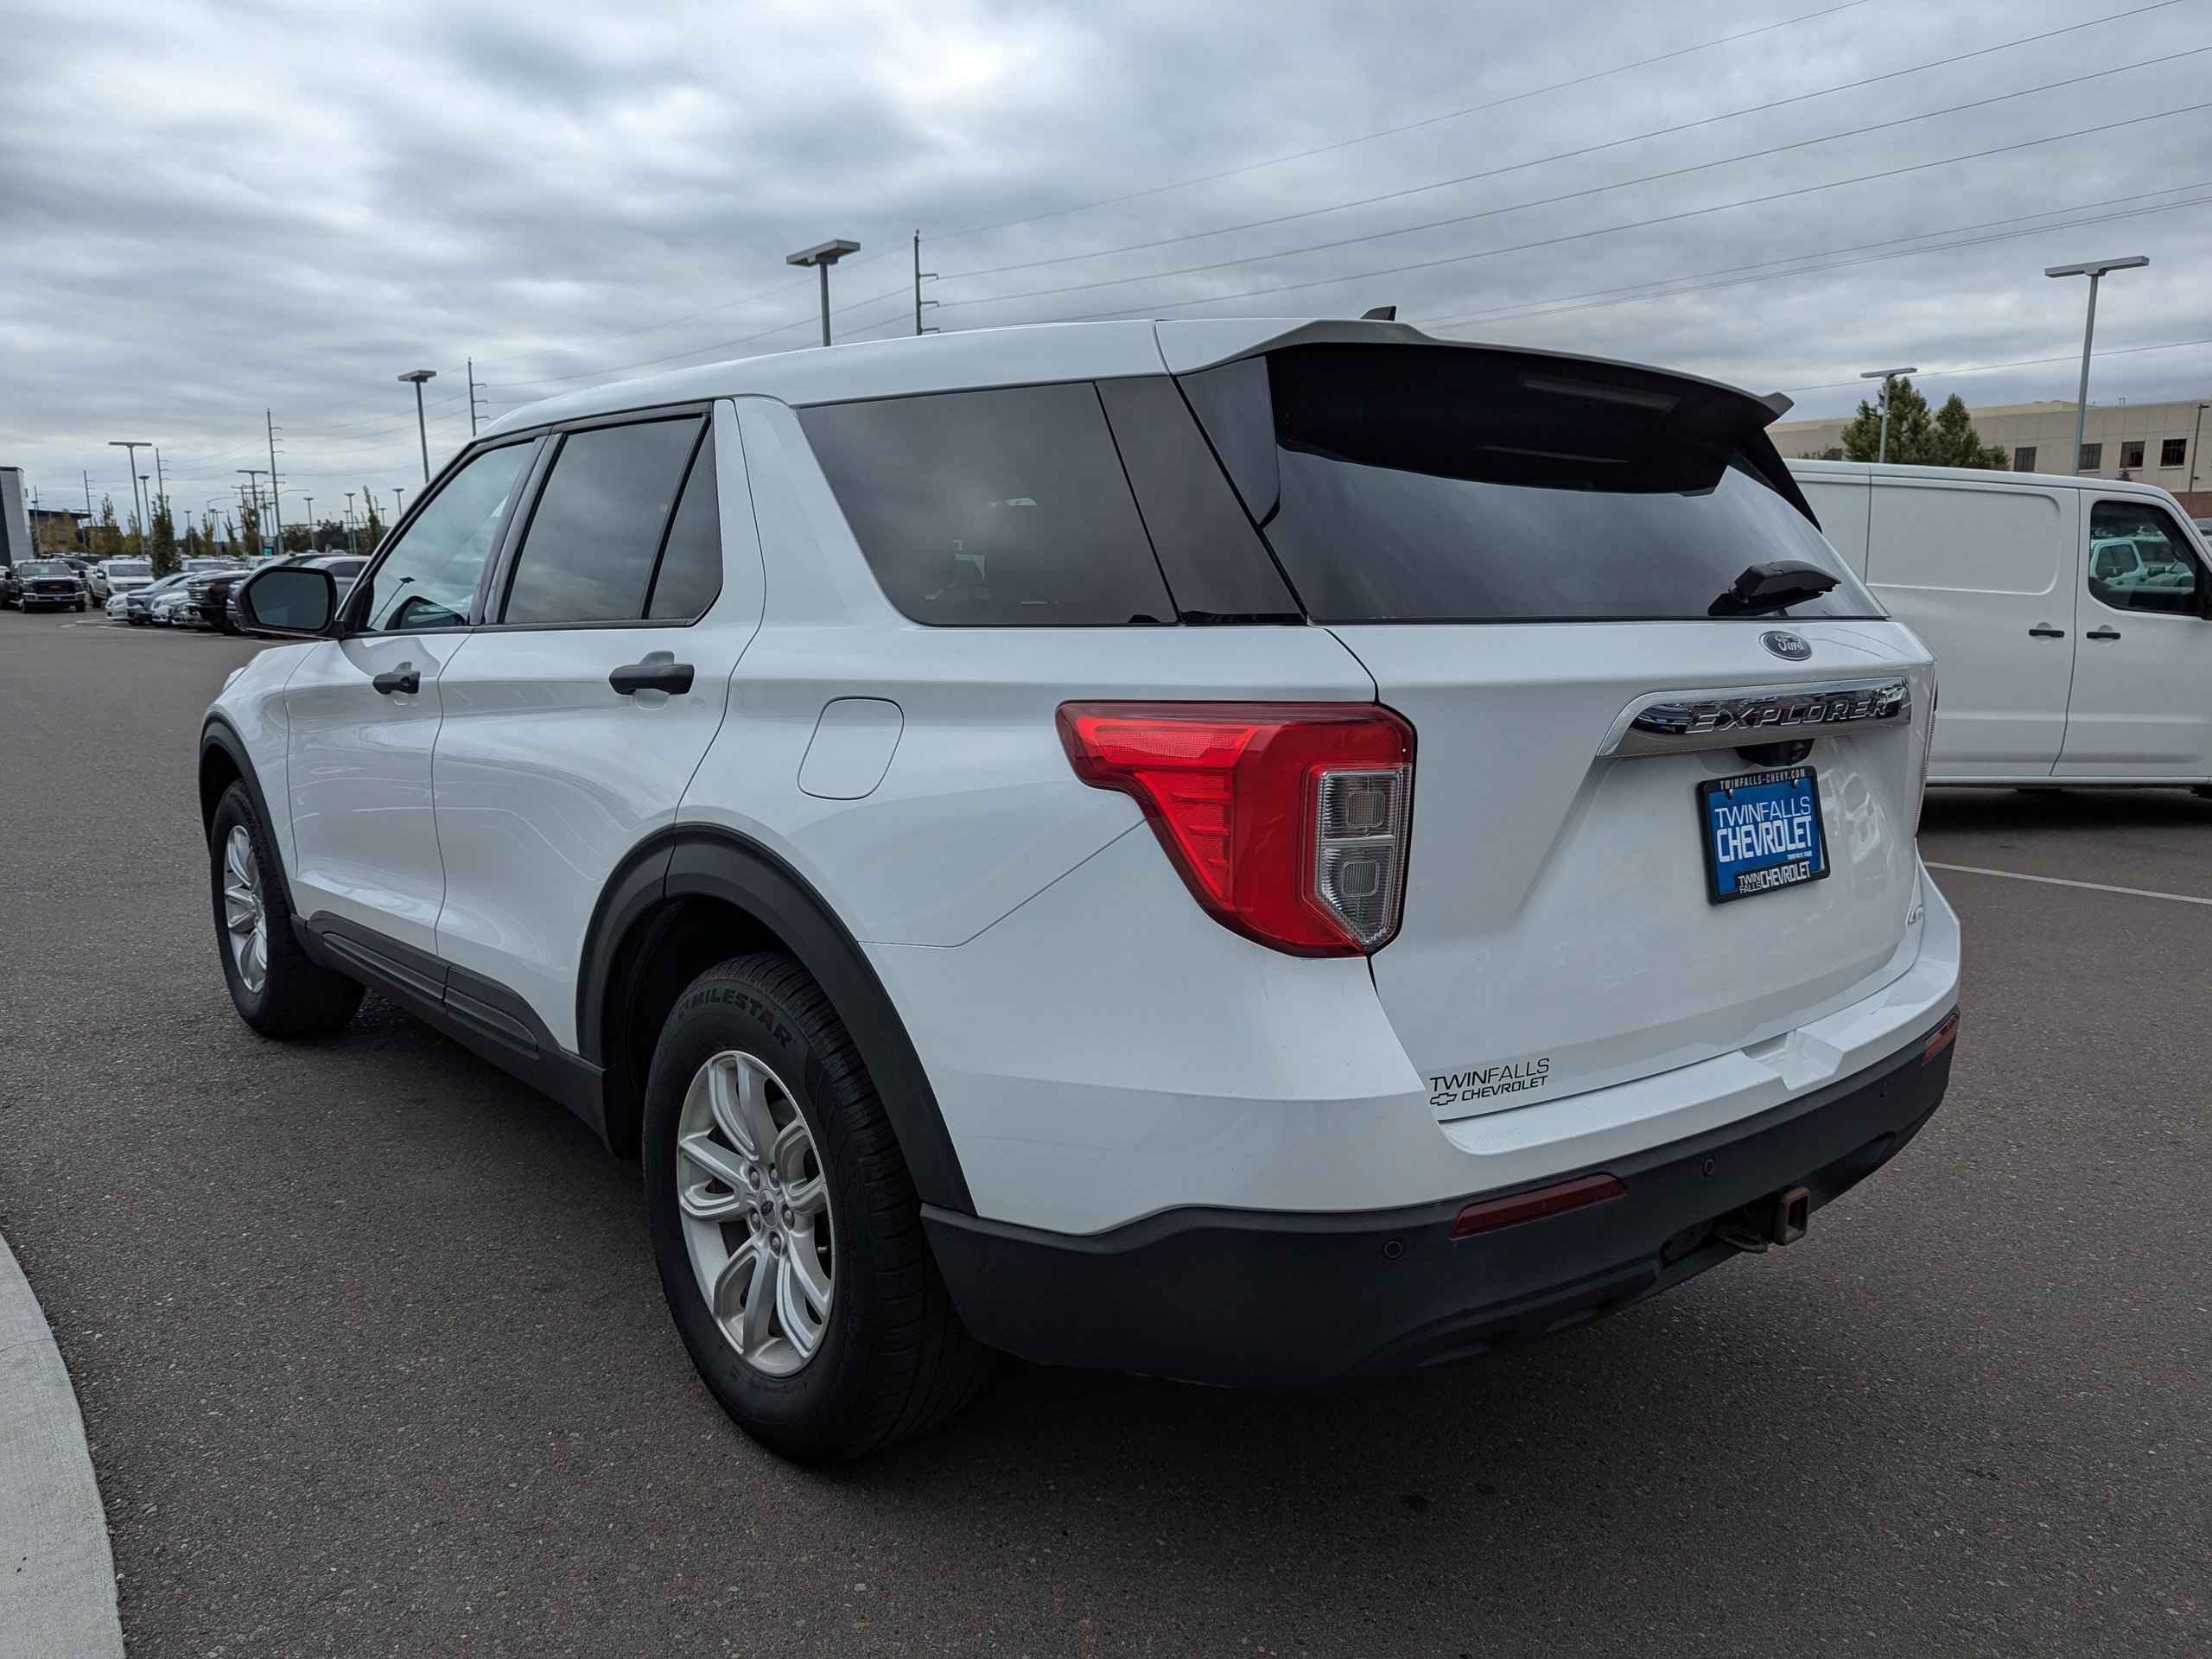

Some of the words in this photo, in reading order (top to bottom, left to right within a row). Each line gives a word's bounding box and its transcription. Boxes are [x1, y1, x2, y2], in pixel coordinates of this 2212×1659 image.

[1774, 635, 1805, 652] Ford
[1686, 696, 1888, 734] EXPLORER
[1719, 768, 1806, 791] TWINFALLS-CHEVY.COM
[1714, 796, 1812, 828] TWINFALLS
[1716, 816, 1812, 862] CHEVROLET
[1738, 872, 1761, 886] TWIN
[1739, 881, 1763, 894] FALLS
[1759, 861, 1811, 889] CHEVROLET
[690, 988, 793, 1050] MILESTAR
[1429, 1058, 1550, 1092] TWINFALLS
[1461, 1075, 1548, 1102] CHEVROLET
